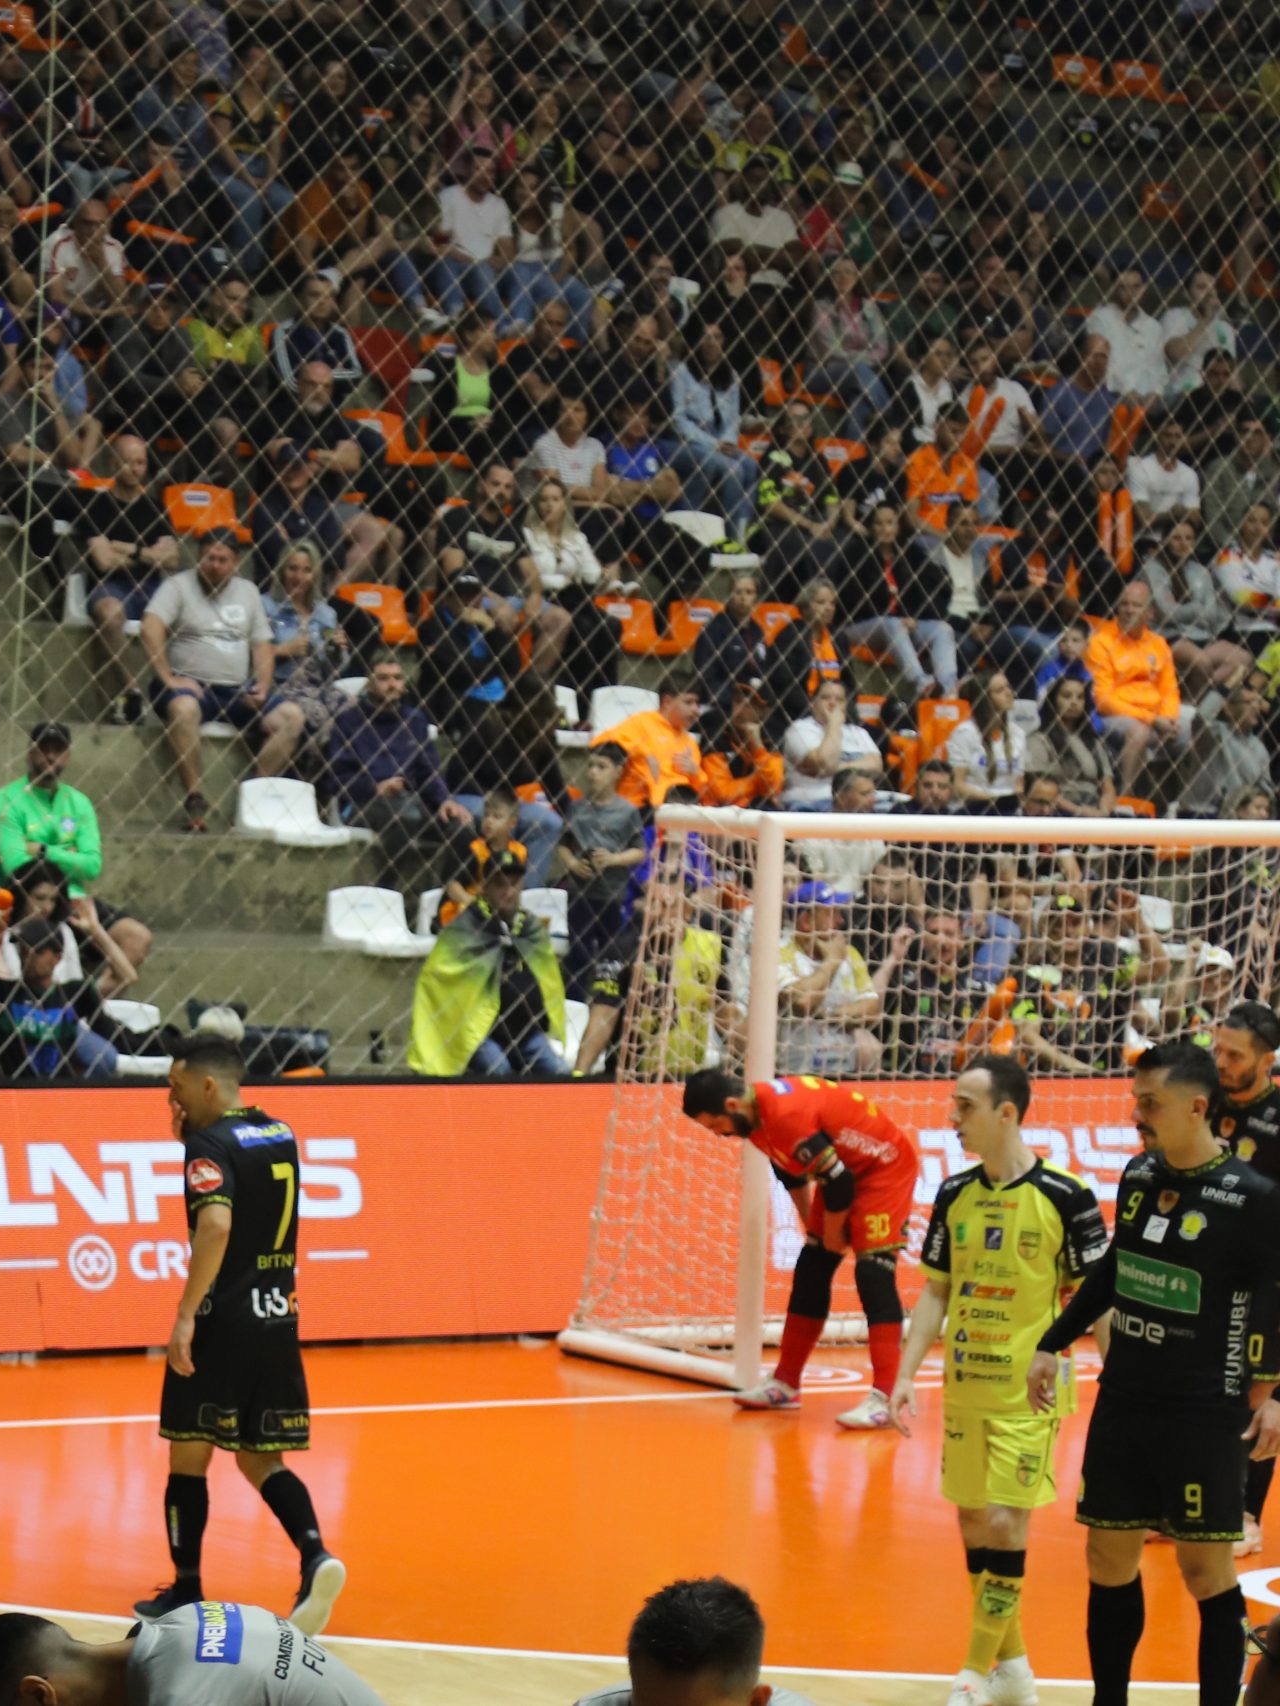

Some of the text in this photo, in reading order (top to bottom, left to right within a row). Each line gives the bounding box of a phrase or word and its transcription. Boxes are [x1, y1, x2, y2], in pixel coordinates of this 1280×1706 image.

[271, 1162, 295, 1250] 7
[1122, 1190, 1145, 1221] 9
[1201, 1185, 1247, 1207] UNIUBE
[865, 1213, 890, 1240] 30
[970, 1308, 1010, 1321] DIPIL
[1224, 1291, 1248, 1378] UNIUBE
[1184, 1483, 1202, 1518] 9
